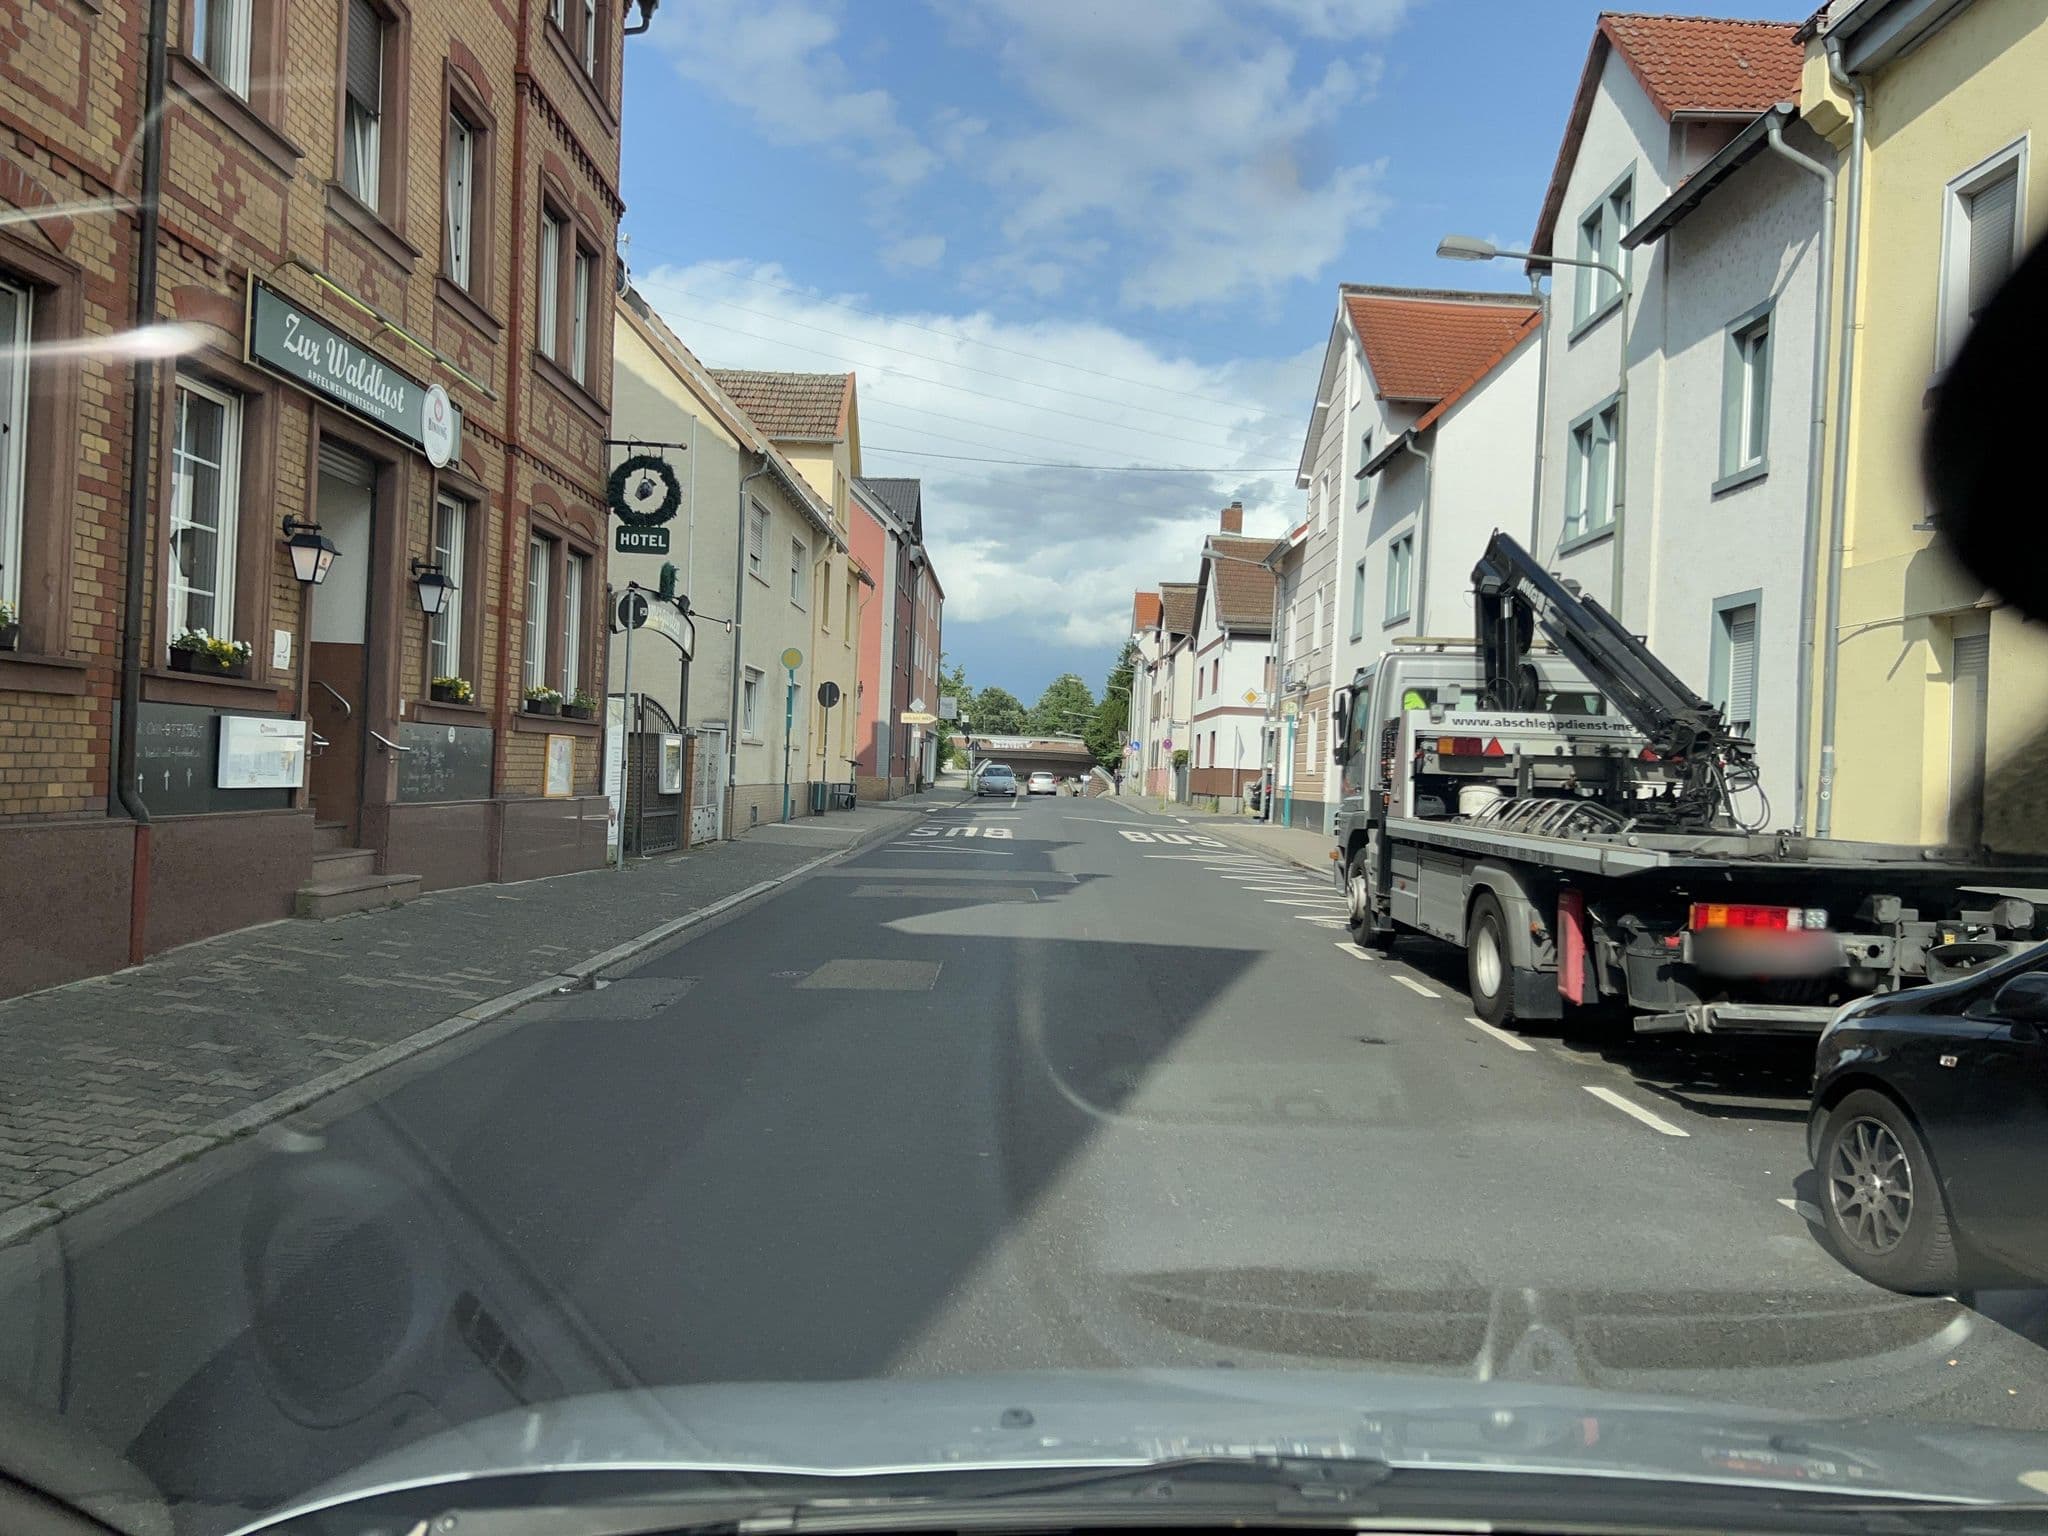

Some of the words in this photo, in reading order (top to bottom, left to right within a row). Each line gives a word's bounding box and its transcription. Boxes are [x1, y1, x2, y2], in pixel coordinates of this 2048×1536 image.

[284, 313, 320, 365] Zur
[326, 338, 404, 413] Waldlust
[307, 369, 385, 418] APFELWEINWIRTSCHAFT
[620, 533, 666, 547] HOTEL
[1452, 717, 1635, 732] www.abschleppdienst-me
[909, 827, 1013, 838] BUS
[1118, 830, 1227, 847] BUS
